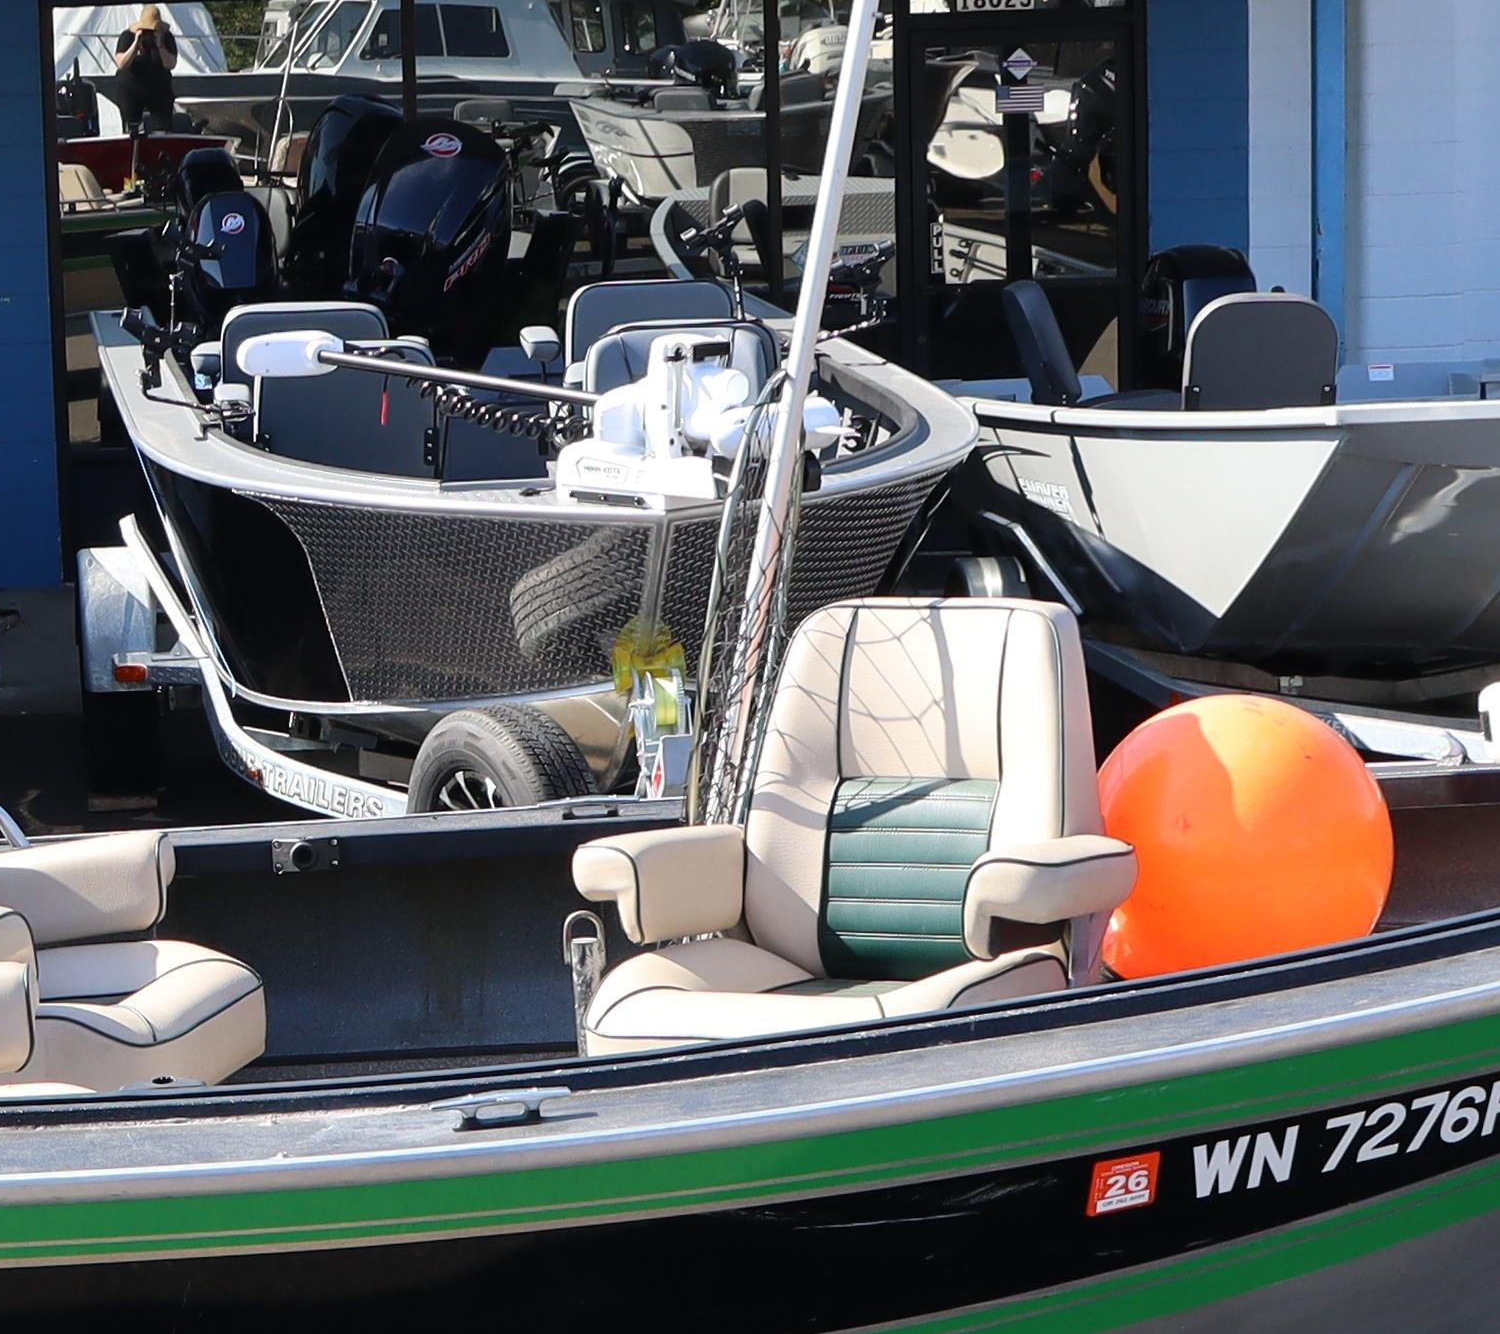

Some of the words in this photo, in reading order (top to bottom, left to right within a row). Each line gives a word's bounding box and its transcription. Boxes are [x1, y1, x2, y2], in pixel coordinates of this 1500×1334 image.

[932, 224, 943, 272] PULL
[262, 760, 384, 818] TRAILERS
[1104, 1169, 1149, 1198] 26
[1193, 1124, 1300, 1198] WN
